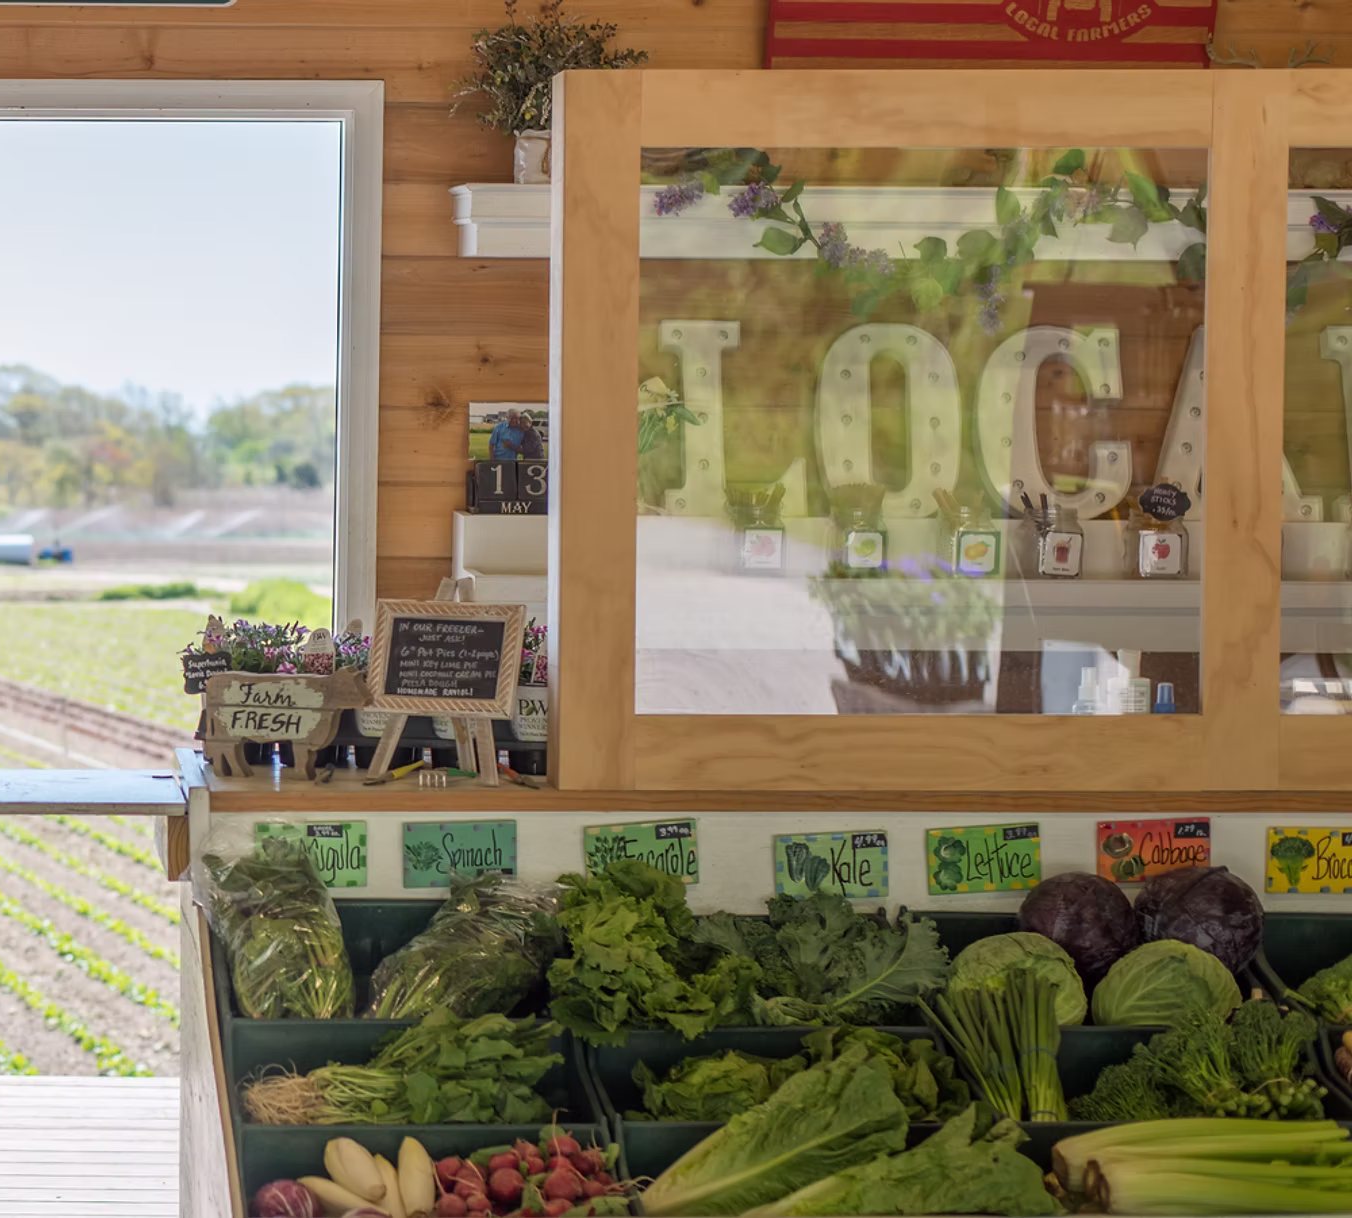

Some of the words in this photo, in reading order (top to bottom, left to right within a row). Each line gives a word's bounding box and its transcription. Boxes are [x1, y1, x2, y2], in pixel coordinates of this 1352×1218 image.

[1006, 2, 1059, 40] LOCAL
[1067, 4, 1152, 42] FARMERS
[658, 320, 1352, 521] LOCA
[1150, 495, 1177, 506] STICKS
[501, 501, 532, 514] MAY
[399, 623, 410, 633] IN
[413, 623, 433, 633] OUR
[418, 634, 442, 642] JUST
[444, 635, 466, 645] ASK!
[417, 646, 433, 657] Pot
[436, 647, 456, 657] Pies
[400, 660, 420, 668] MINI
[422, 661, 438, 669] KEY
[440, 661, 461, 669] LIME
[455, 671, 482, 679] CREAM
[428, 679, 458, 688] DOUGH
[239, 683, 297, 706] Farm
[397, 687, 438, 696] HOMEMADE
[231, 710, 302, 734] FRESH
[436, 829, 502, 875] Spinach
[1138, 831, 1207, 867] Cabbage
[965, 832, 1034, 884] Lettuce
[829, 839, 874, 897] Kale
